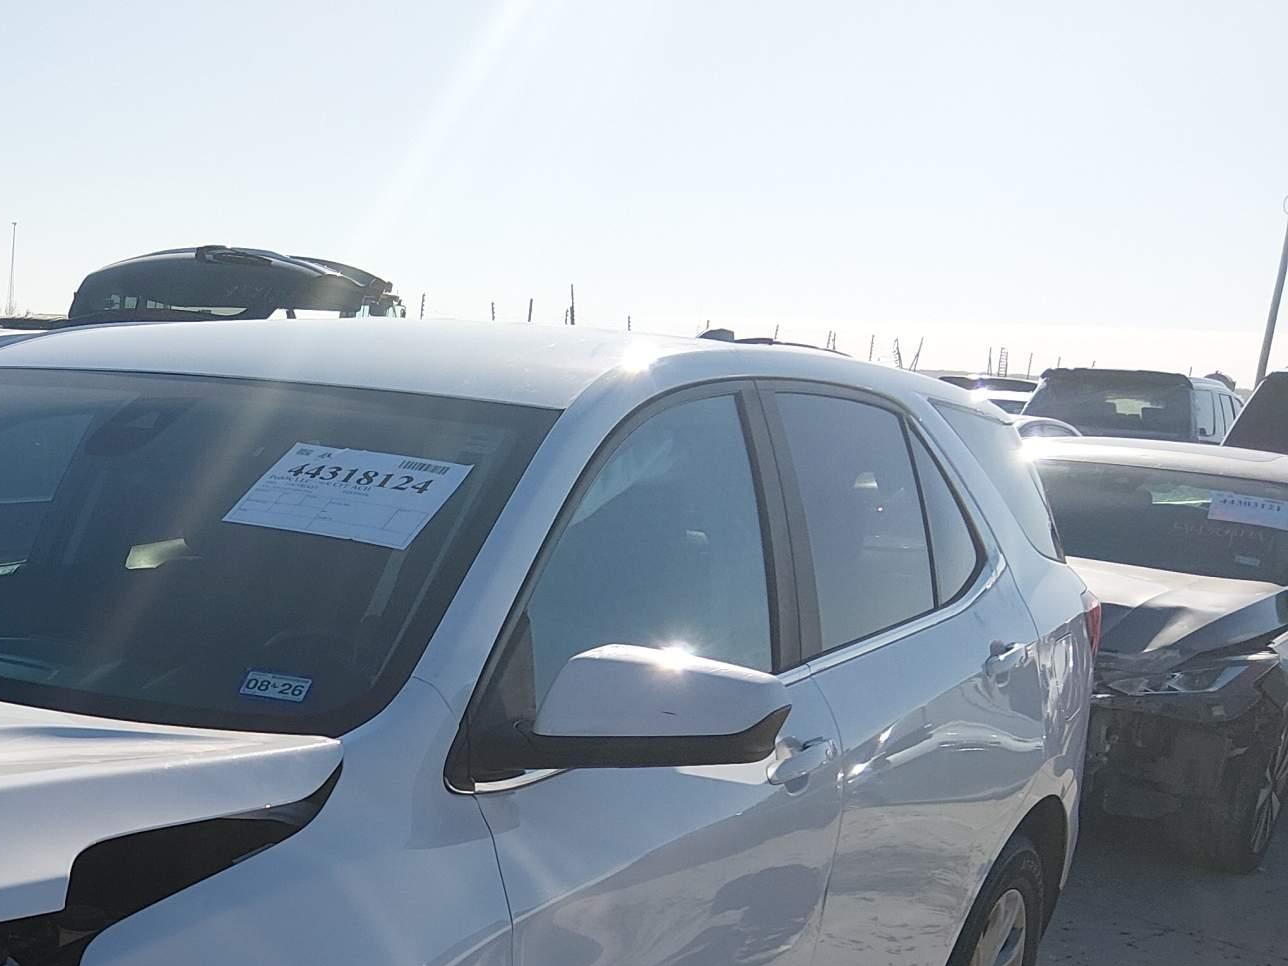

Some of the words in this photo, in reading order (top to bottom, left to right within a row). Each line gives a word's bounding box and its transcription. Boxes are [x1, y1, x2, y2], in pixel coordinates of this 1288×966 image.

[287, 463, 434, 494] 44318124
[246, 678, 272, 692] 08
[278, 682, 305, 697] 26
